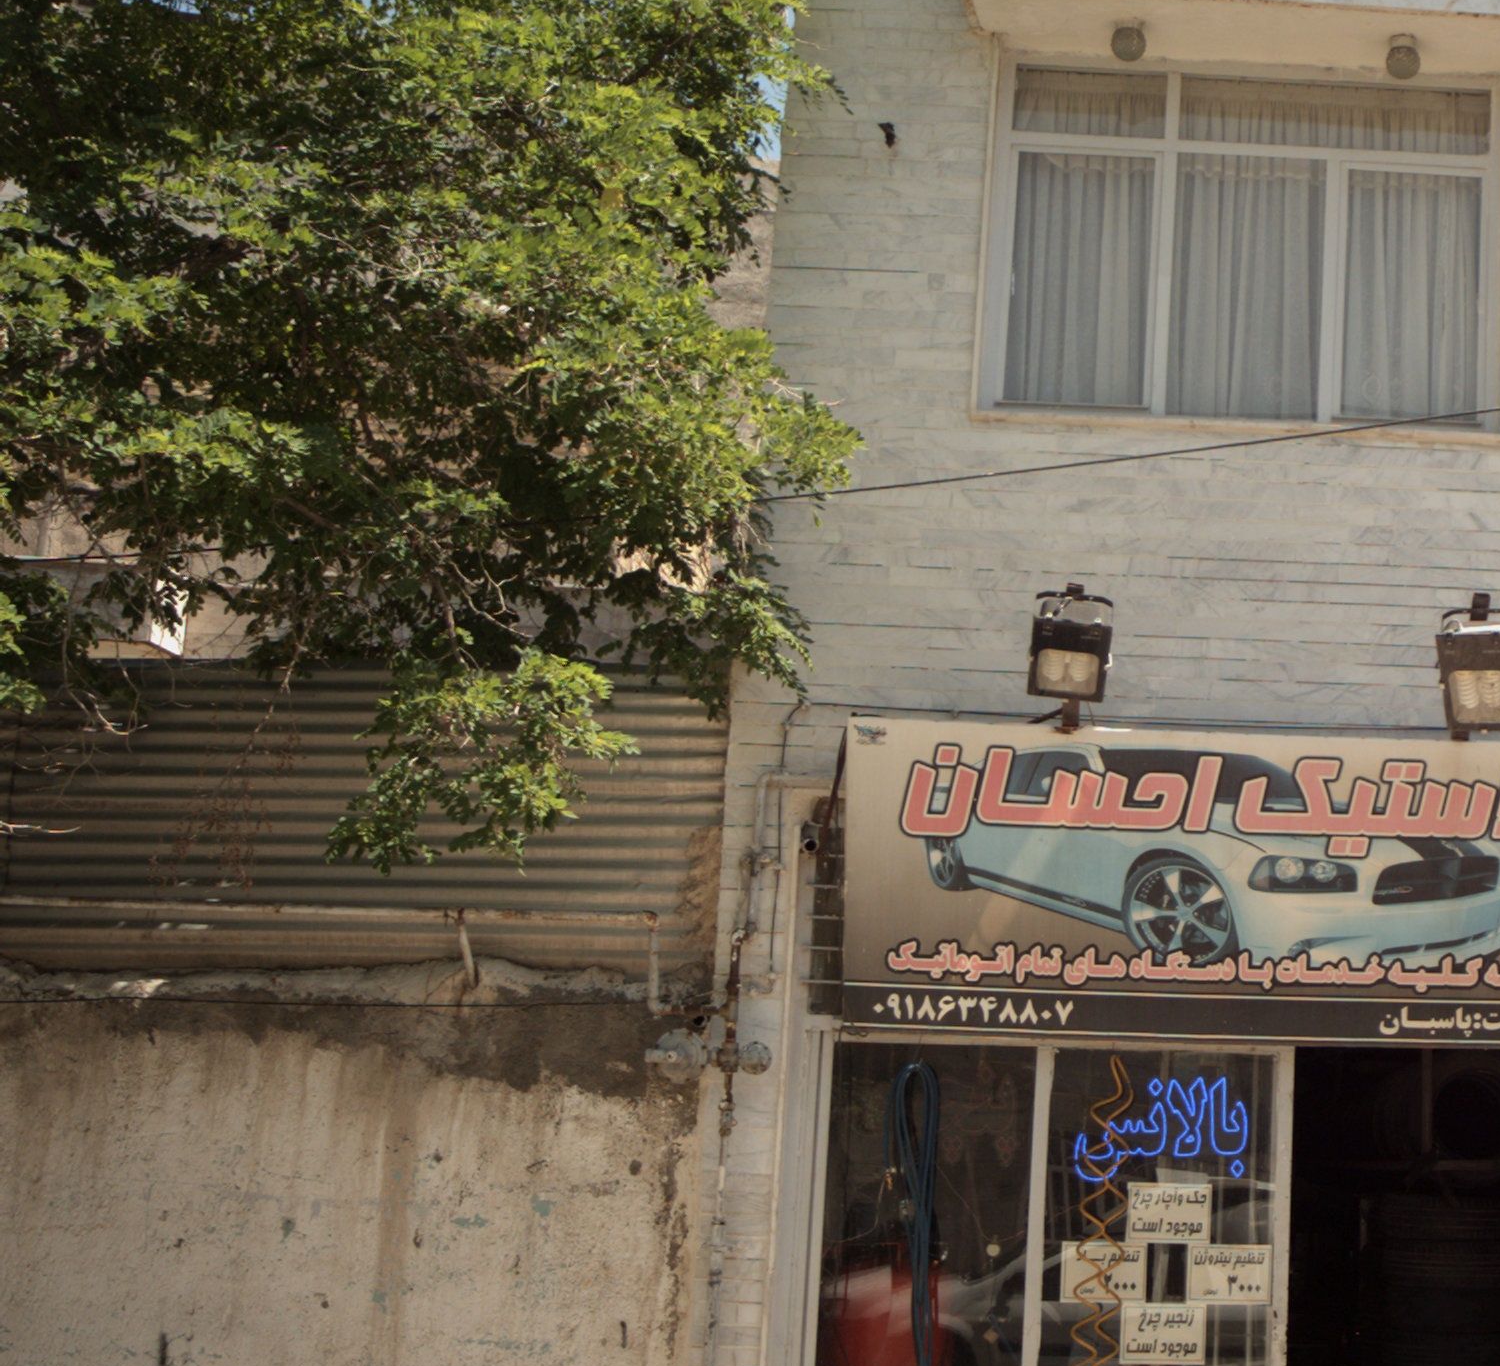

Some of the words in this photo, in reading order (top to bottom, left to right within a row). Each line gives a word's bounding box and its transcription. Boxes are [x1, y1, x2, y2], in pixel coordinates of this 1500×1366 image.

[900, 742, 1223, 836] احسان
[888, 939, 1014, 982] اتوماتیک
[1015, 945, 1062, 984] تمام
[1064, 946, 1127, 985] های
[1129, 949, 1235, 982] دستگاه
[1238, 951, 1274, 990] با
[1275, 953, 1385, 986] خدمات
[1387, 953, 1485, 993] کلیه
[873, 993, 1074, 1025] ۰۹۱۸۶۳۴۸۸۰۷
[1074, 1076, 1248, 1182] بالانس
[1132, 1189, 1153, 1210] چرخ
[1186, 1191, 1207, 1208] جک
[1132, 1217, 1163, 1232] است
[1166, 1222, 1203, 1237] موجود
[1194, 1249, 1232, 1267] نیتروژن
[1232, 1251, 1265, 1271] تنظیم
[1227, 1275, 1261, 1296] ۳۰۰۰
[1138, 1309, 1161, 1332] چرخ
[1163, 1309, 1195, 1328] زنجیر
[1126, 1338, 1158, 1354] است
[1160, 1342, 1198, 1358] موجود
